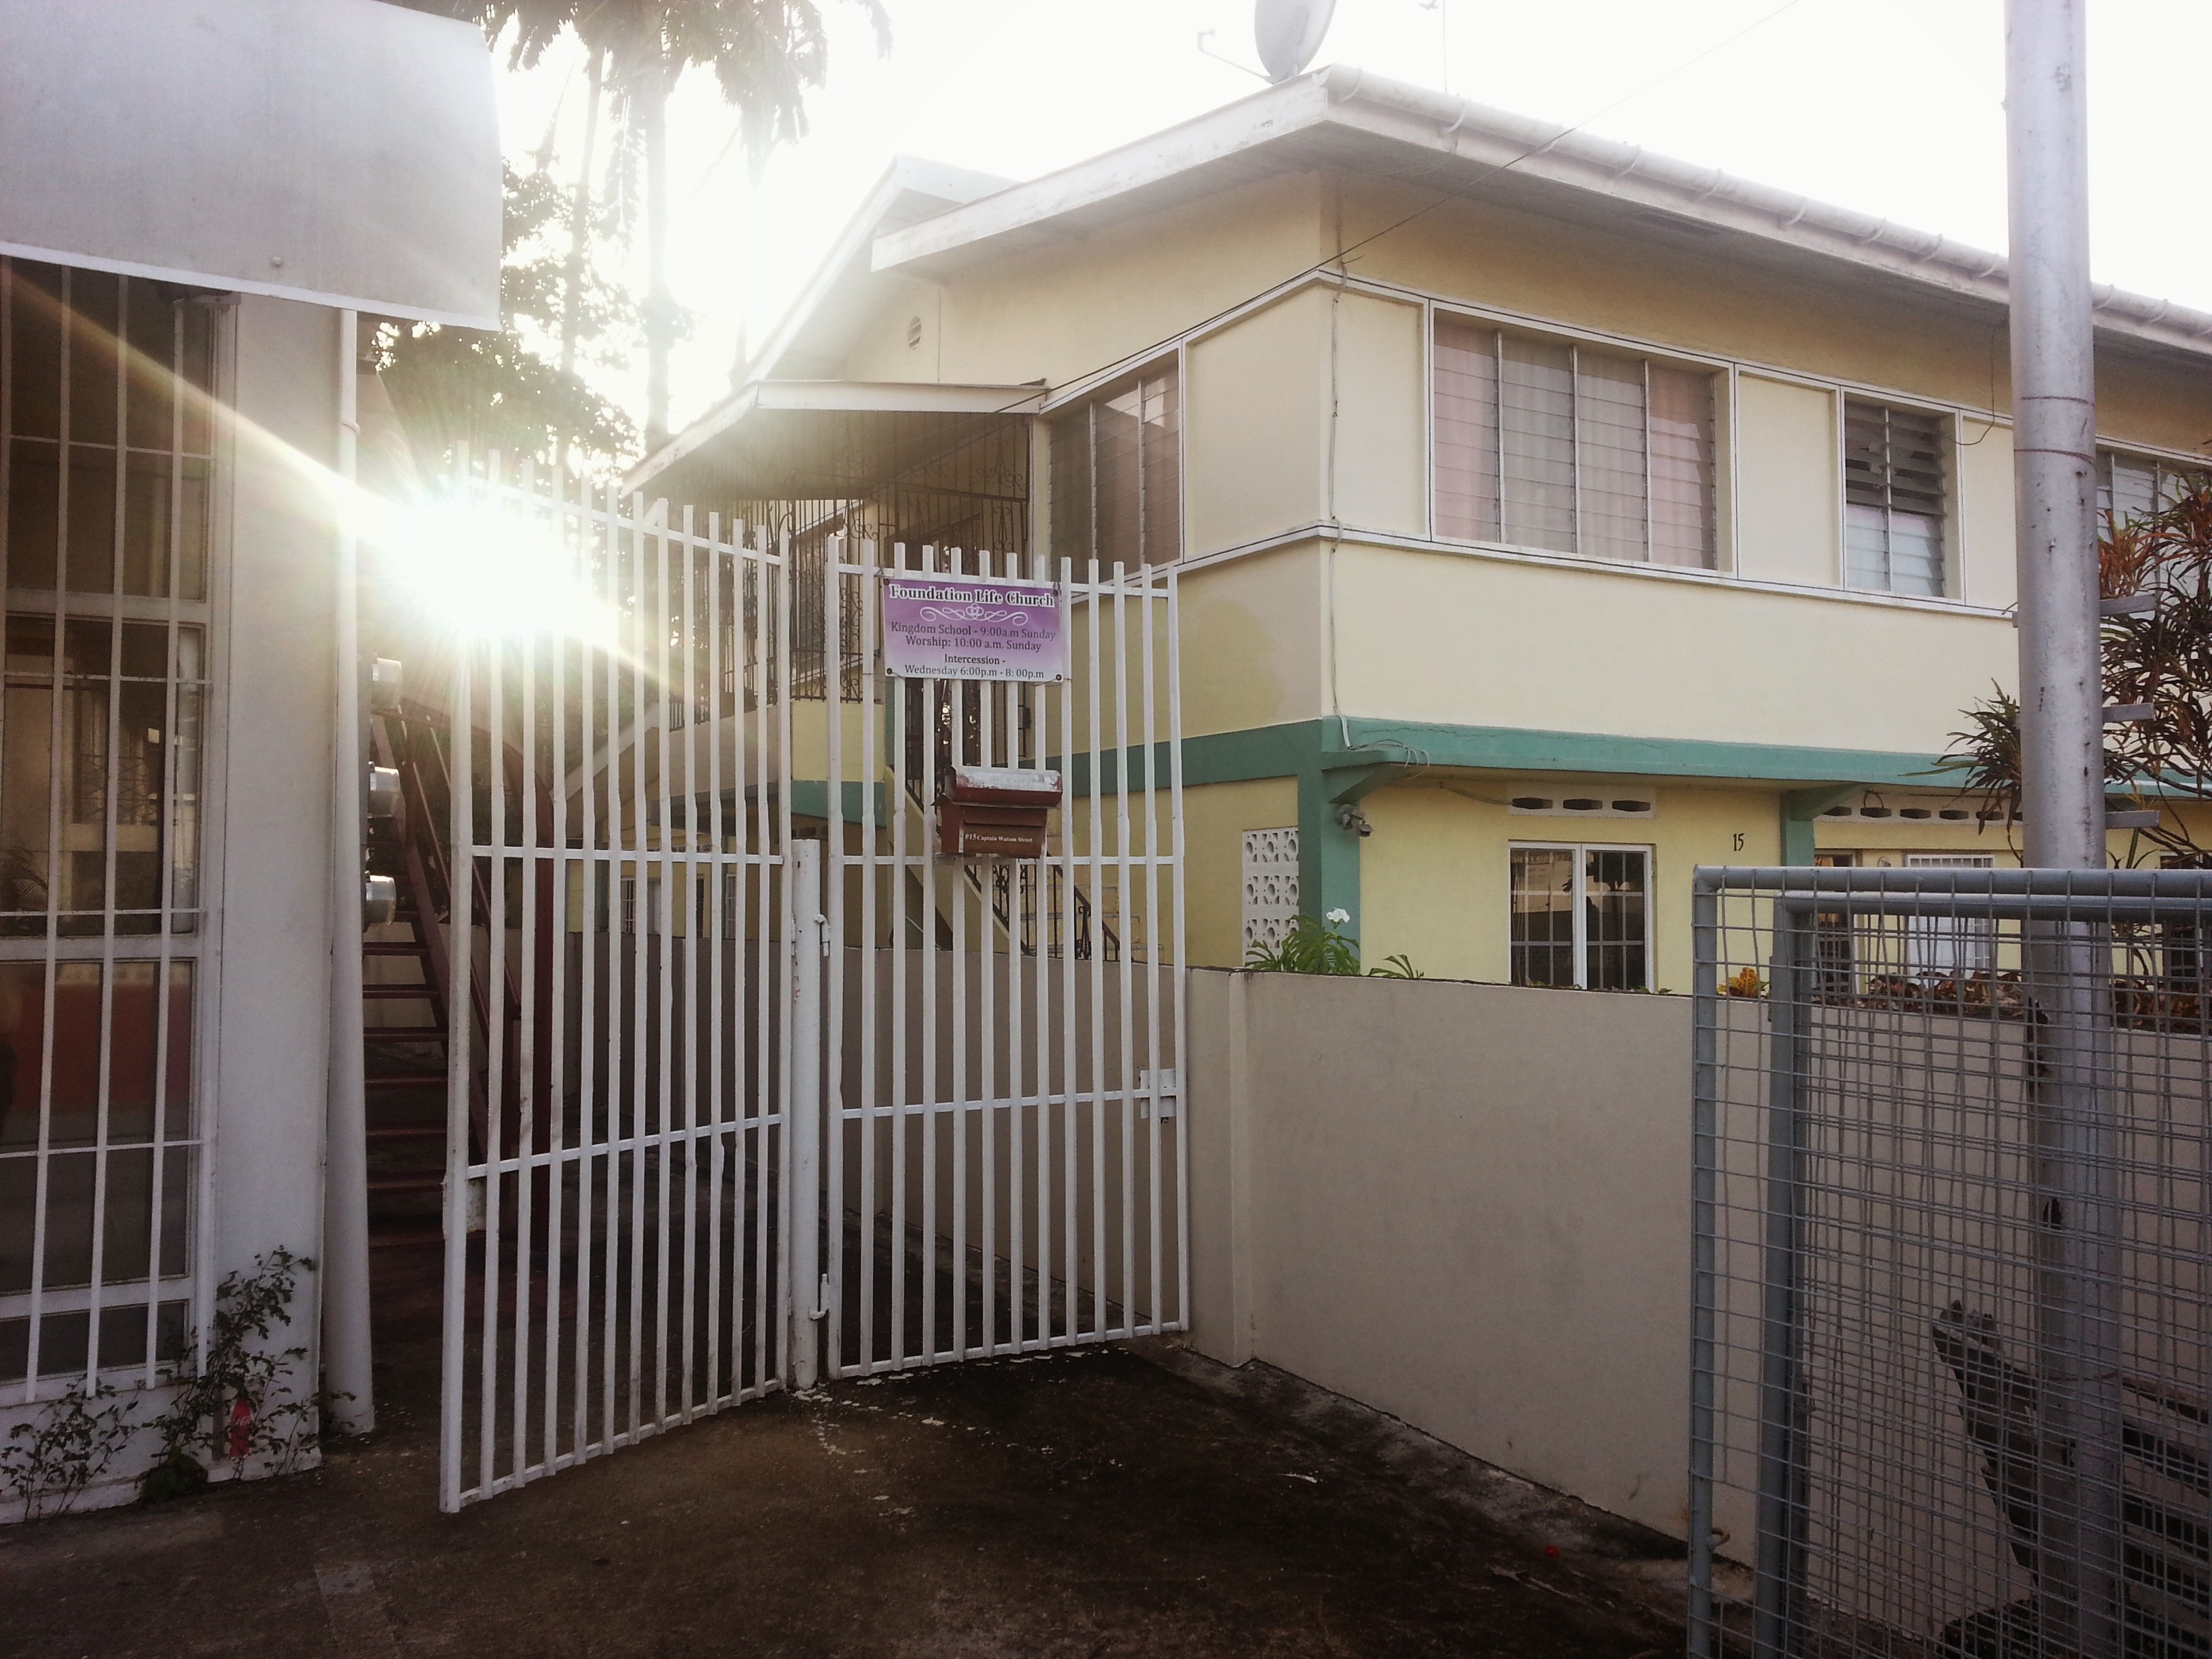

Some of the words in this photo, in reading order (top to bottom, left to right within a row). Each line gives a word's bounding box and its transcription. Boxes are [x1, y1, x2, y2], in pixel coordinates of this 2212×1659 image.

[889, 584, 972, 603] Foundation
[975, 590, 1002, 605] Life
[1006, 592, 1055, 607] Church
[891, 622, 936, 634] Kingdom
[939, 625, 971, 635] School
[980, 626, 1019, 638] 9:00a.m
[1021, 630, 1055, 640] Sunday
[905, 636, 951, 649] Worship:
[954, 638, 981, 648] 10:00
[984, 641, 1004, 649] a.m.
[1006, 640, 1042, 653] Sunday
[945, 655, 1000, 665] Intercession
[905, 665, 958, 676] Wednesday
[960, 668, 997, 677] 6:00p.m
[1733, 833, 1744, 851] 15
